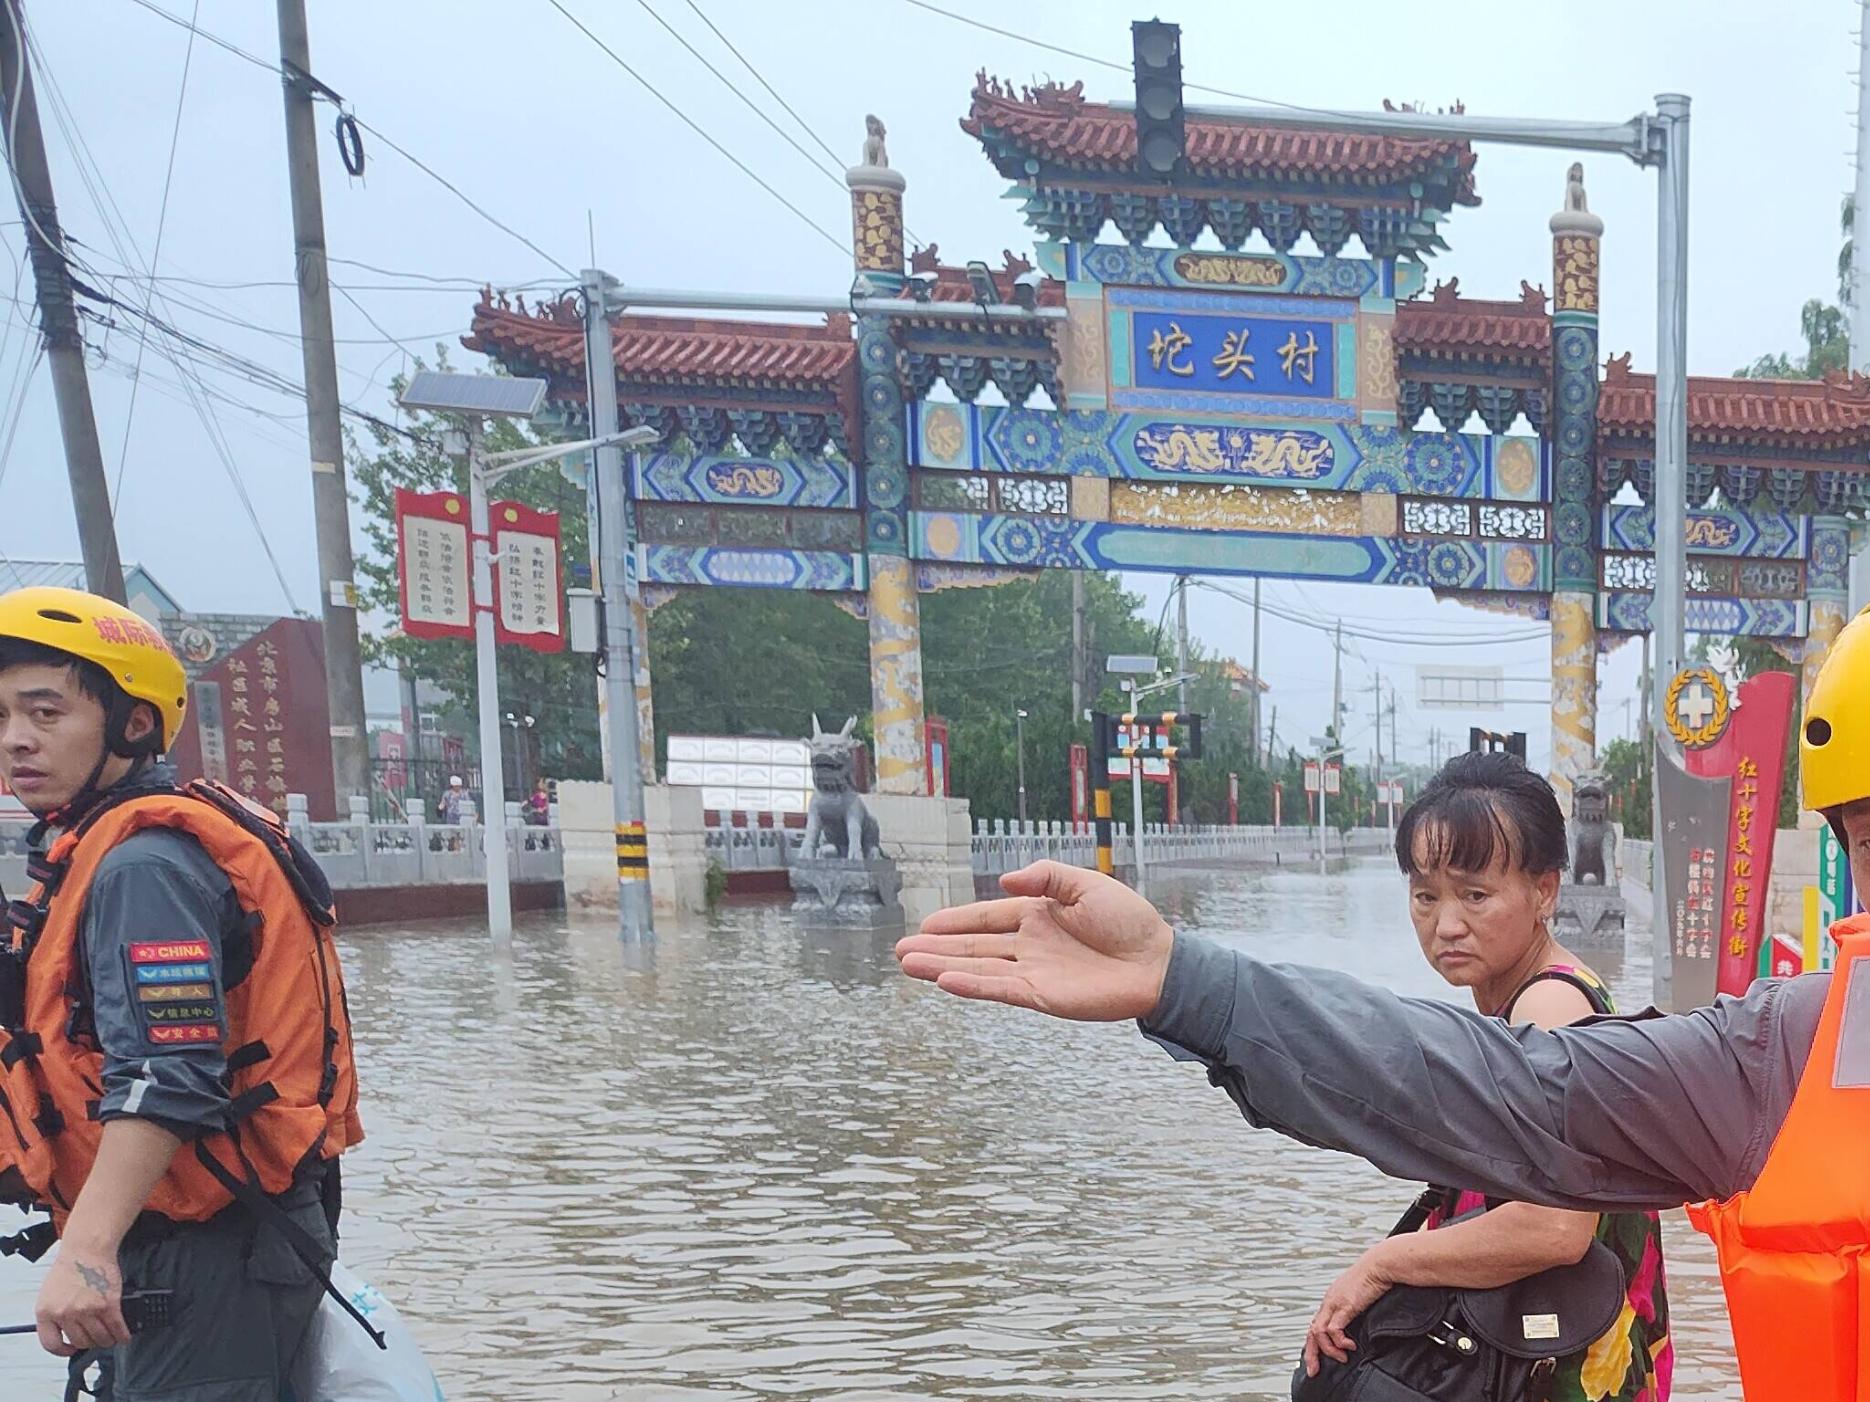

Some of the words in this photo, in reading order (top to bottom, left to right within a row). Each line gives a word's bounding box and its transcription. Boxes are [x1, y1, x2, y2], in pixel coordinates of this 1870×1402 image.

[1147, 320, 1319, 385] 坨头村
[1728, 756, 1759, 960] 红十字文化宣传街
[158, 945, 205, 958] CHINA
